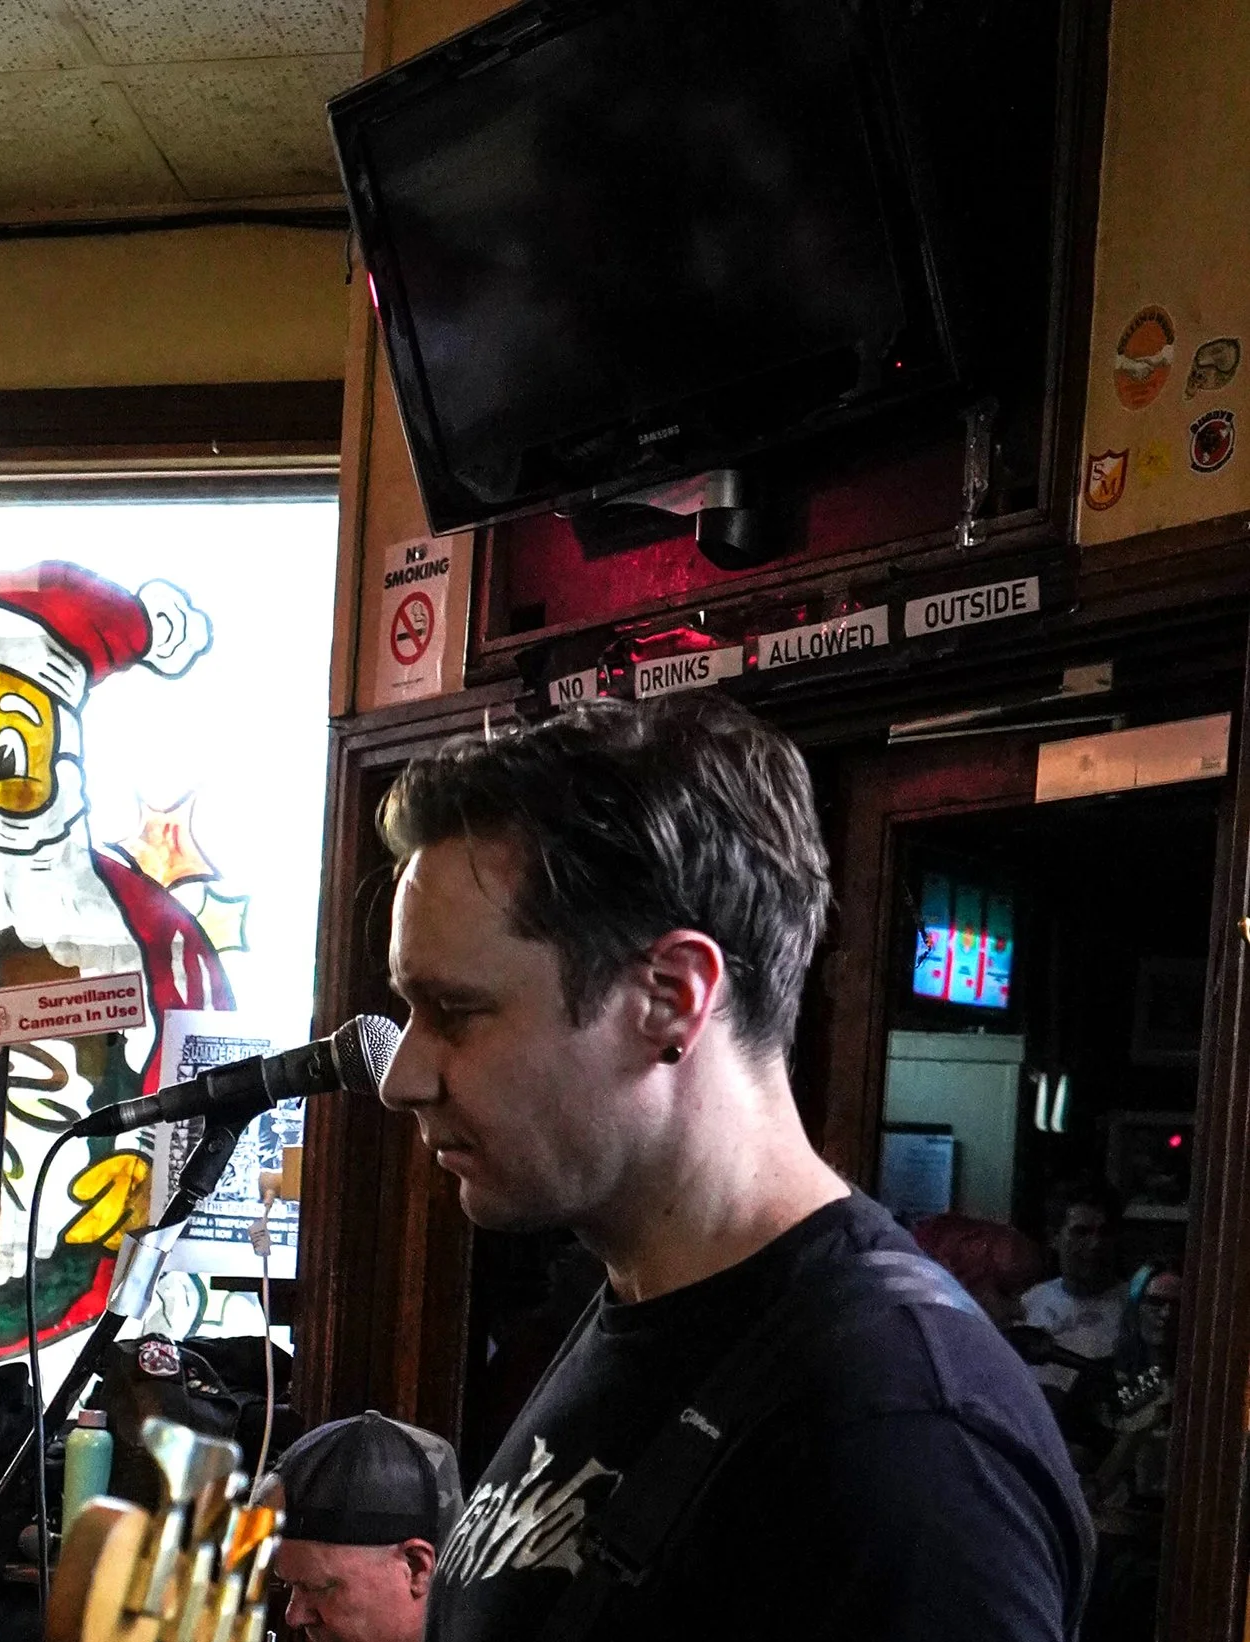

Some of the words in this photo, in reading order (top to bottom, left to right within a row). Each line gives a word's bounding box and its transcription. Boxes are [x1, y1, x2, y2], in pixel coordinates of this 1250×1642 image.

[405, 544, 428, 565] NO
[384, 557, 450, 589] SMOKING
[557, 677, 583, 701] NO
[640, 656, 710, 693] DRINKS
[768, 623, 875, 665] ALLOWED
[924, 581, 1027, 629] OUTSIDE
[38, 985, 136, 1009] Surveillance
[18, 1011, 82, 1031] Camera
[86, 1008, 102, 1022] In
[105, 1004, 138, 1019] Use
